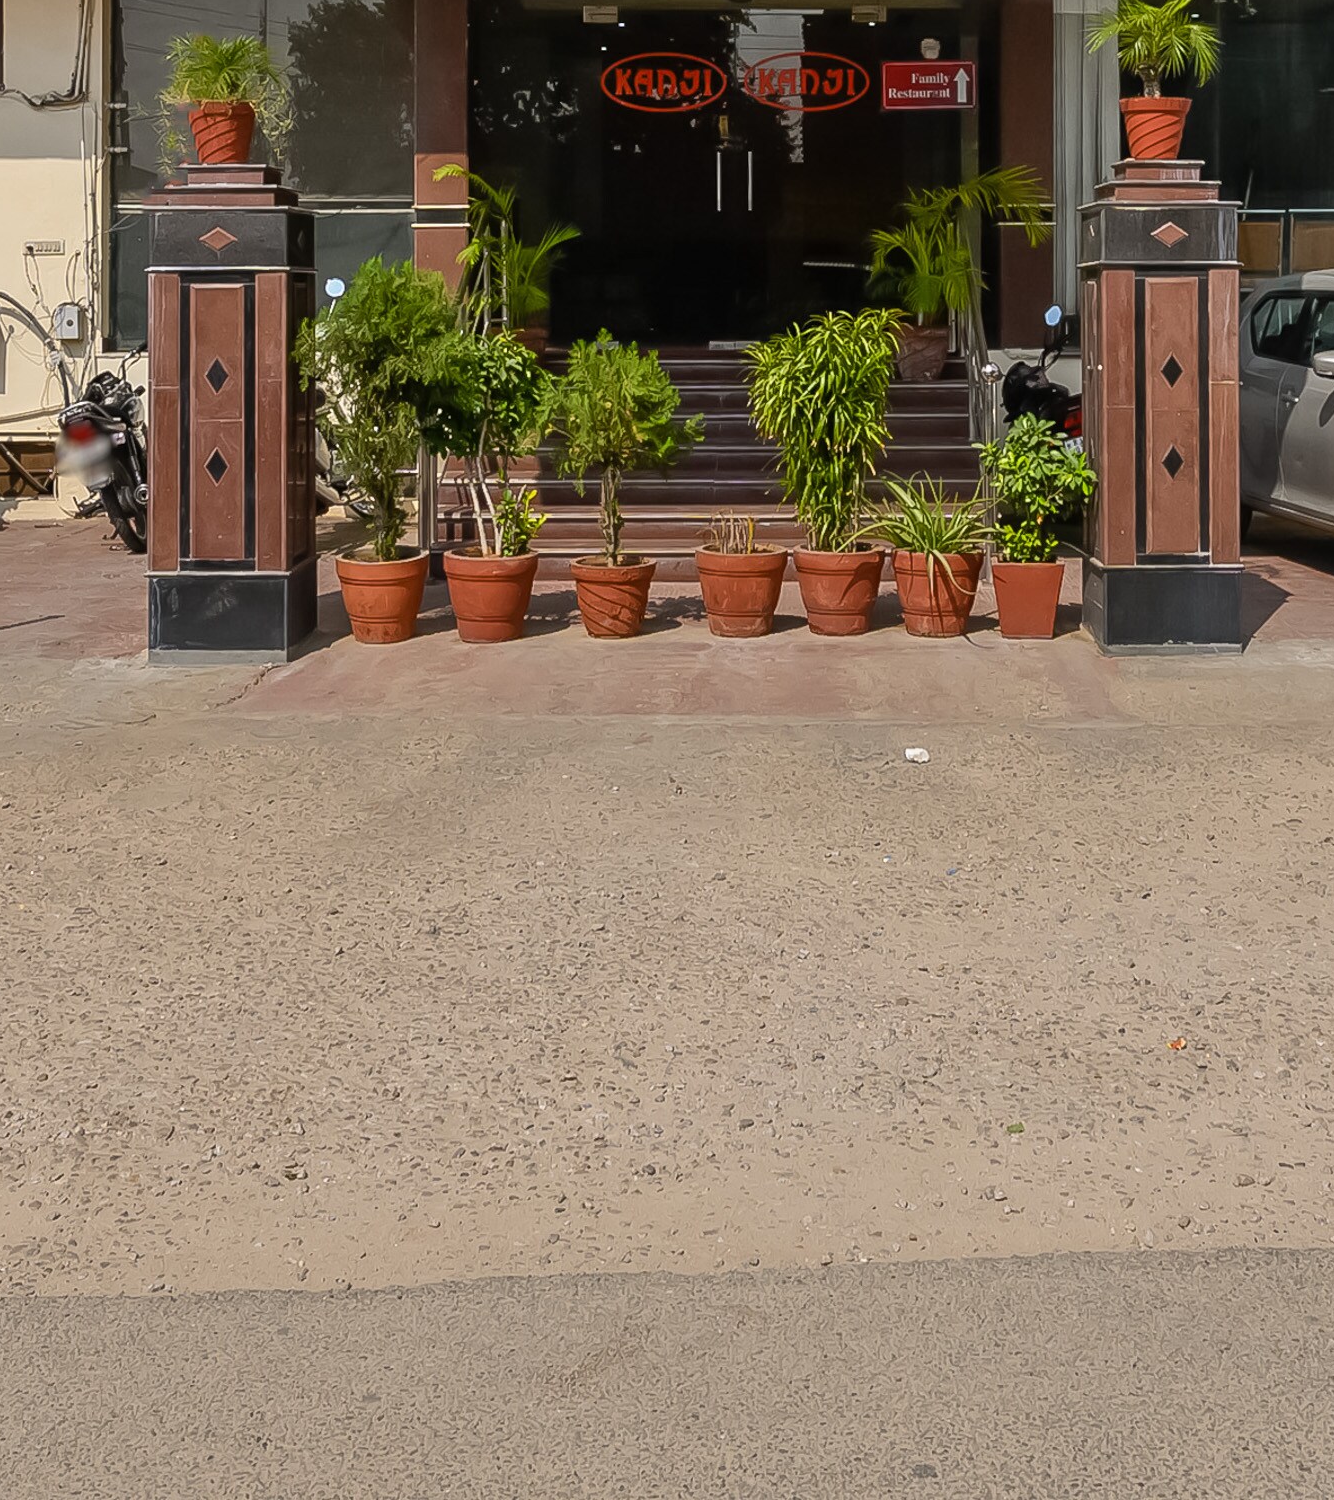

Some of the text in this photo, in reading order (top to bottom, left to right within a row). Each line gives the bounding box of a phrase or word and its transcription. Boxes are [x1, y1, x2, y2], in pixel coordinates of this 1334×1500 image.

[614, 68, 713, 96] KANJI
[757, 68, 856, 96] KANJI
[911, 72, 951, 86] Family
[888, 87, 951, 99] Restaurant
